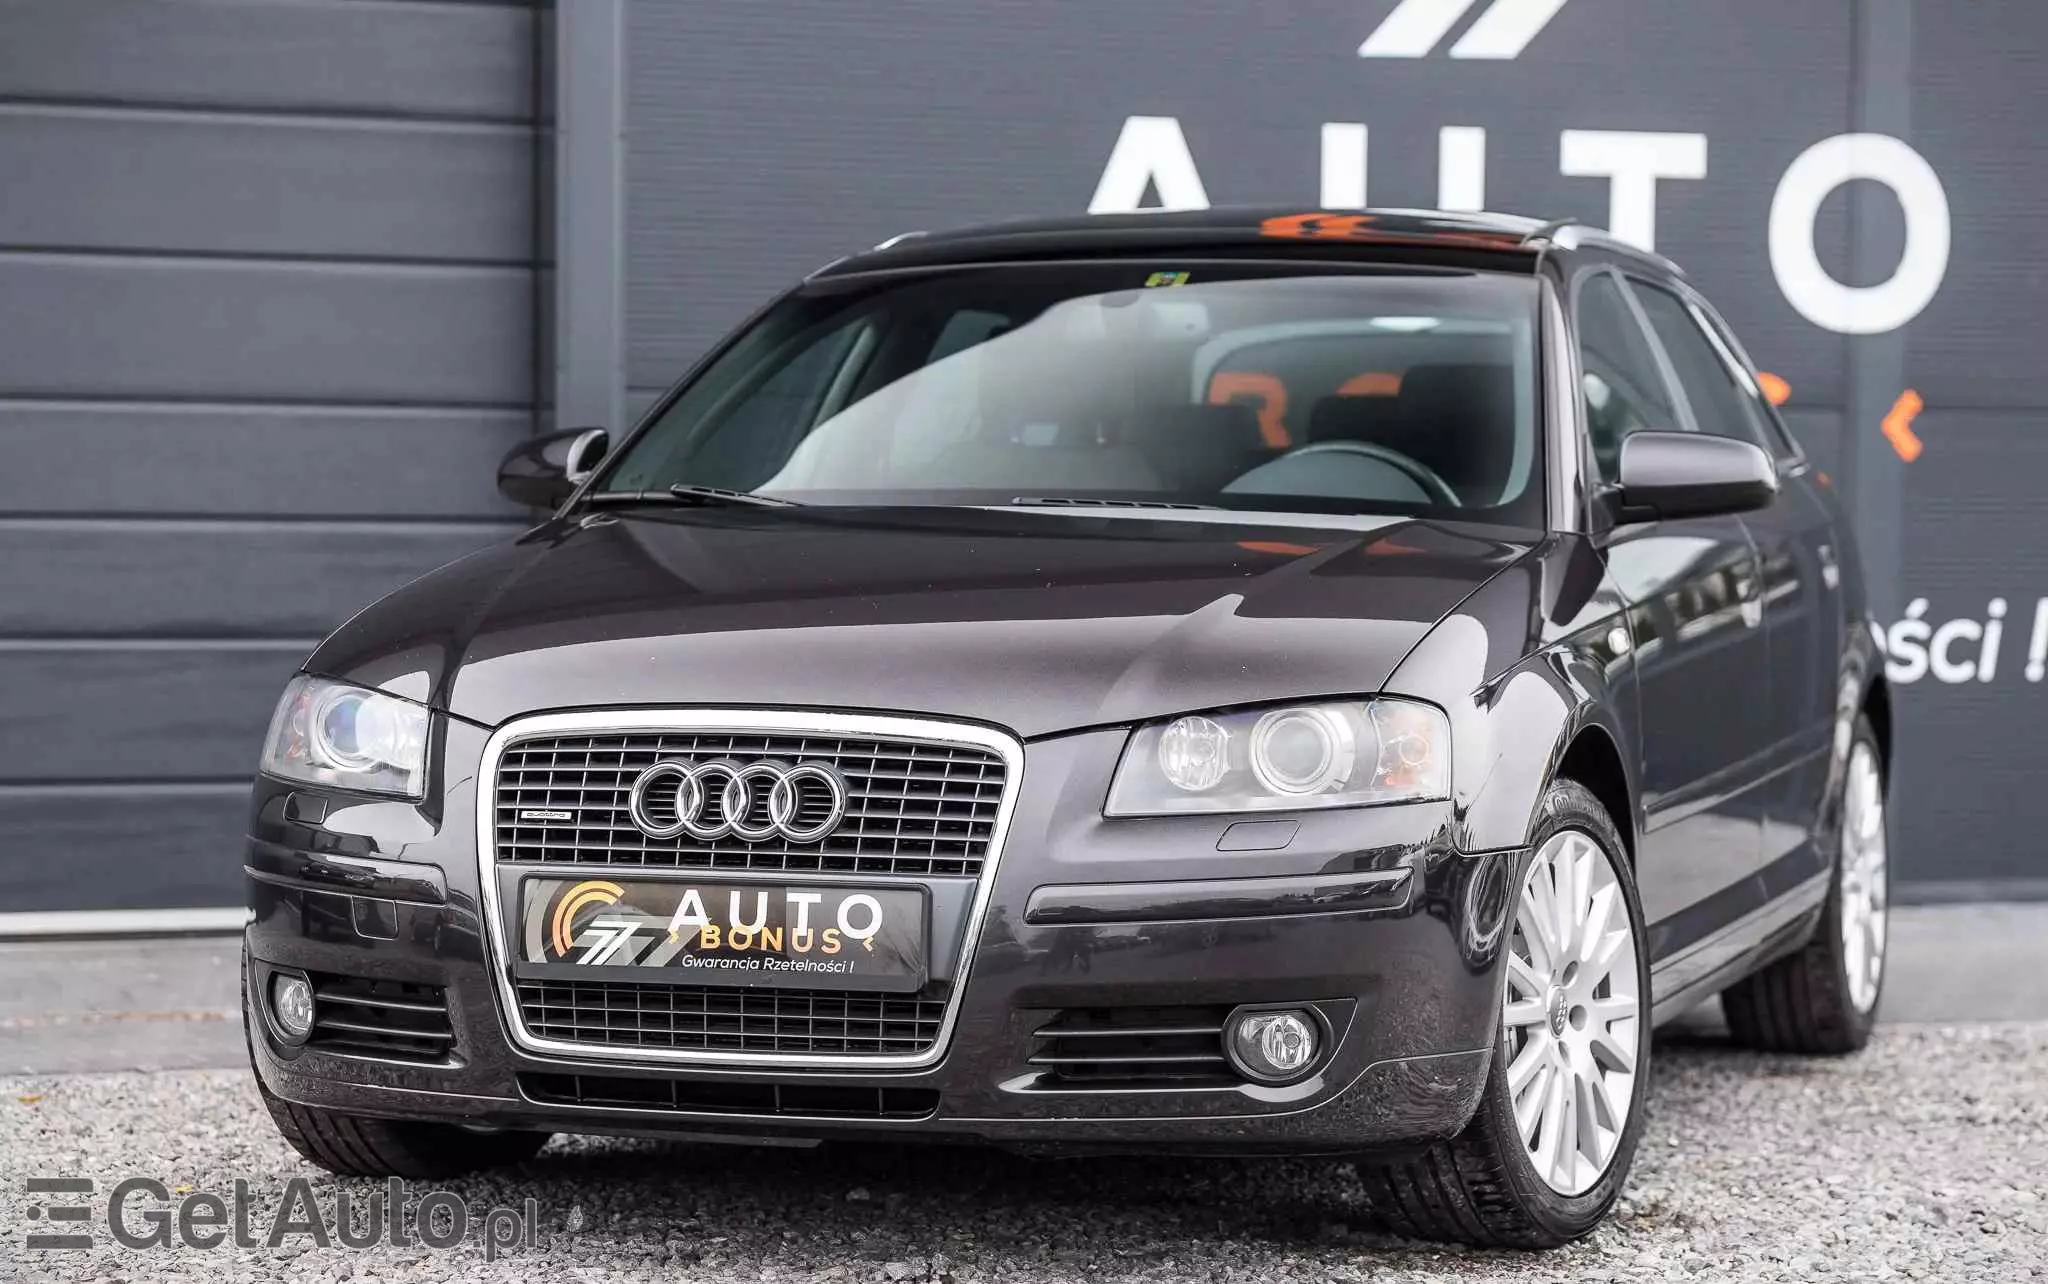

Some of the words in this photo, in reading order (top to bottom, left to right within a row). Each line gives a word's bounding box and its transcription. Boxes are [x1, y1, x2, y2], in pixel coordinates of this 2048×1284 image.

[667, 888, 883, 940] AUTO
[700, 924, 842, 954] BONUS
[681, 954, 760, 971] Gwarancja
[763, 957, 847, 974] Rzetelności
